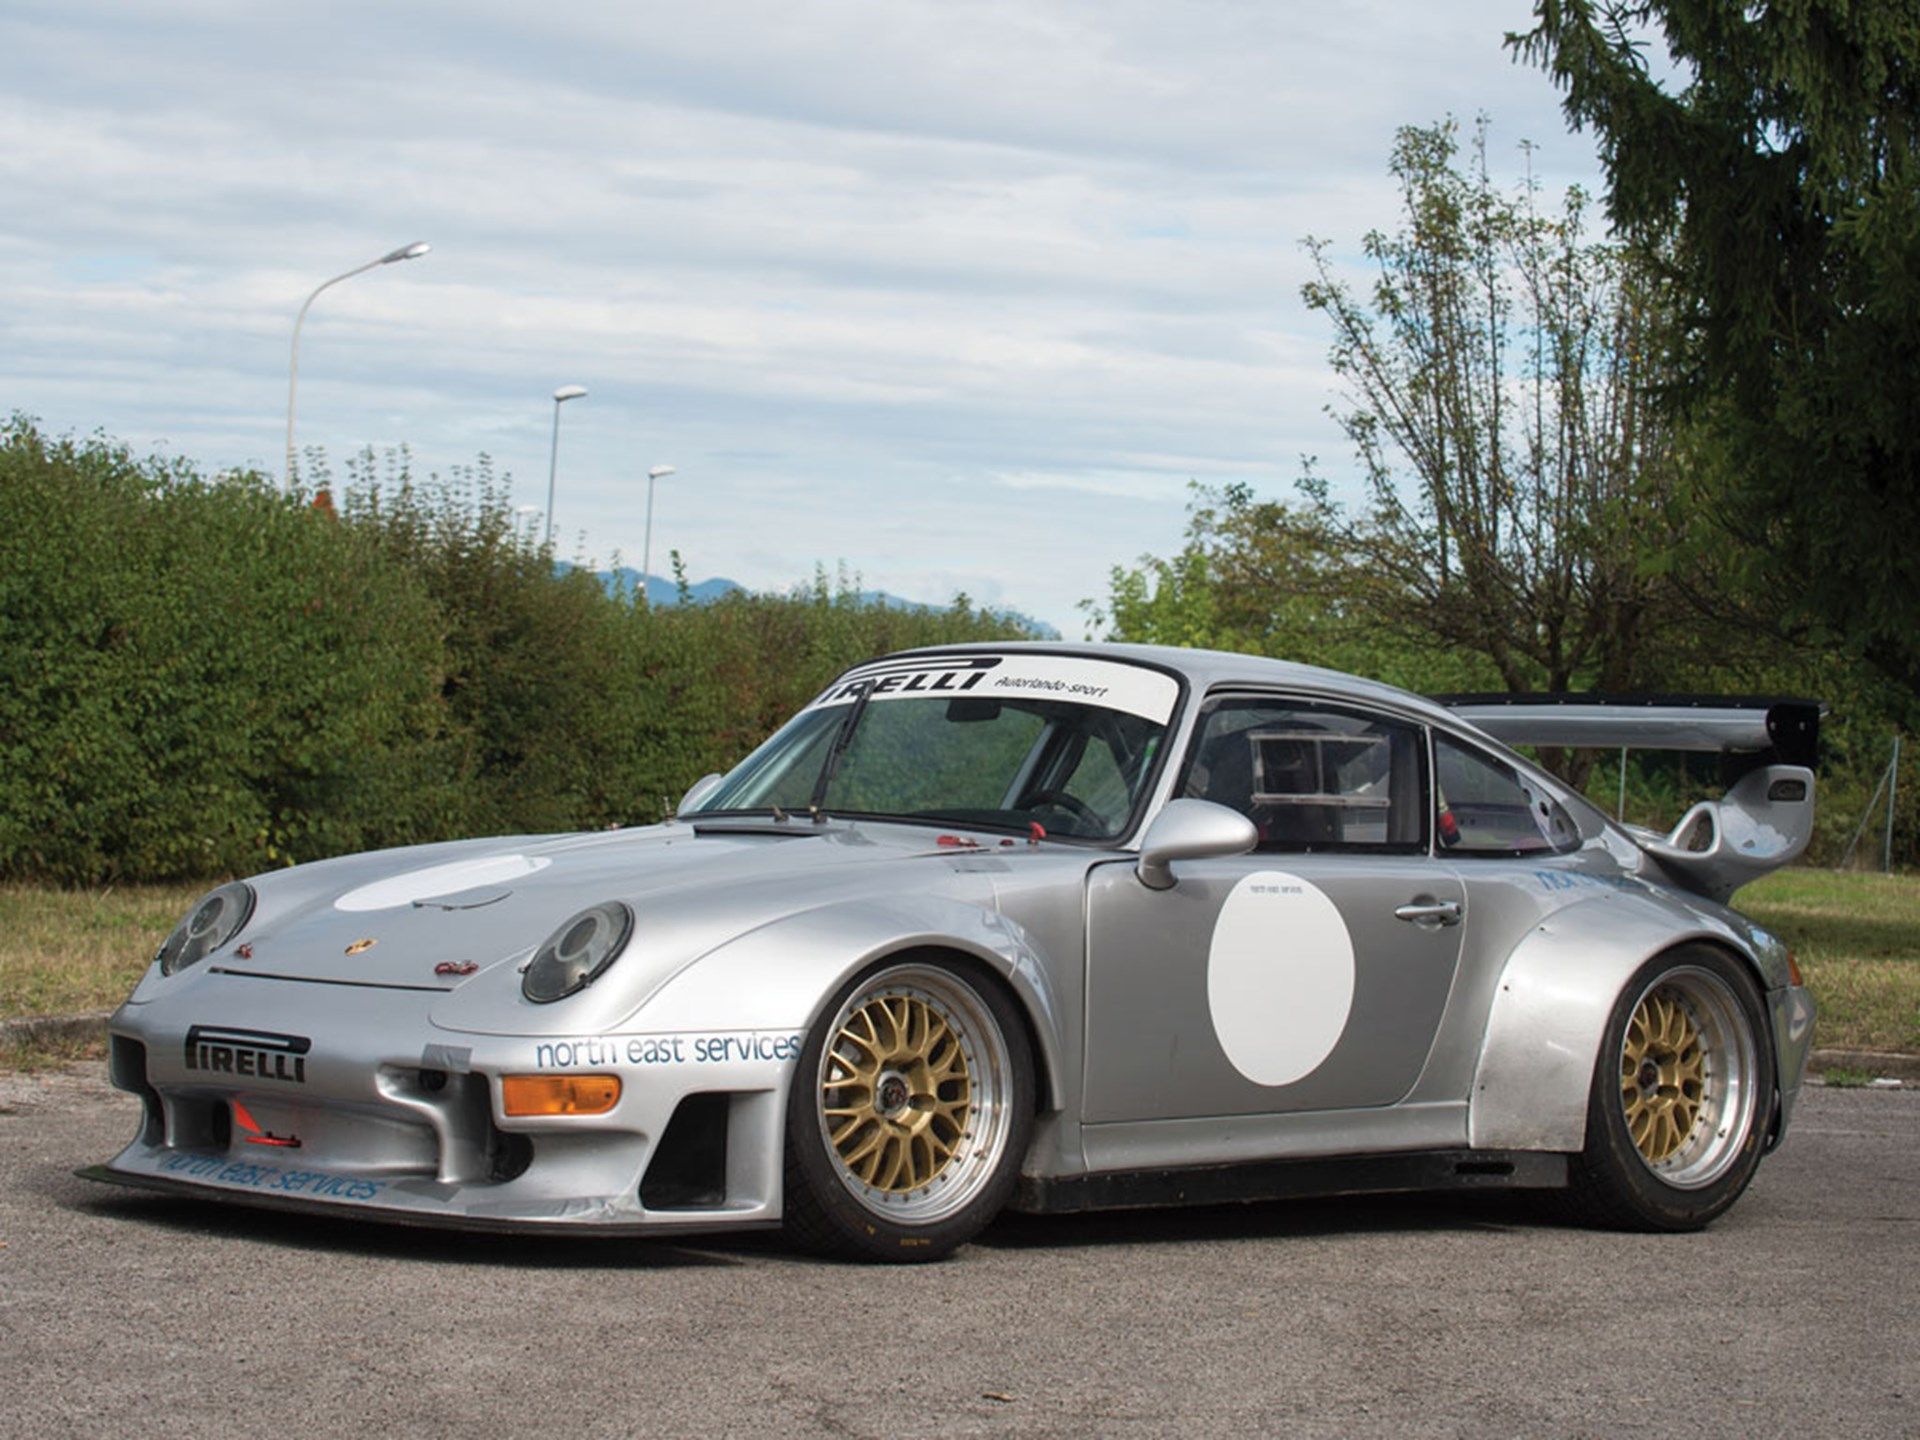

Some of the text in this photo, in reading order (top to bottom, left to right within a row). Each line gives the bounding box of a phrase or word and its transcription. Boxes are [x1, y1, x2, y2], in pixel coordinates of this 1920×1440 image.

[184, 1024, 312, 1083] PIRELLI
[626, 1036, 685, 1065] east
[694, 1031, 801, 1062] services
[271, 1170, 385, 1200] services
